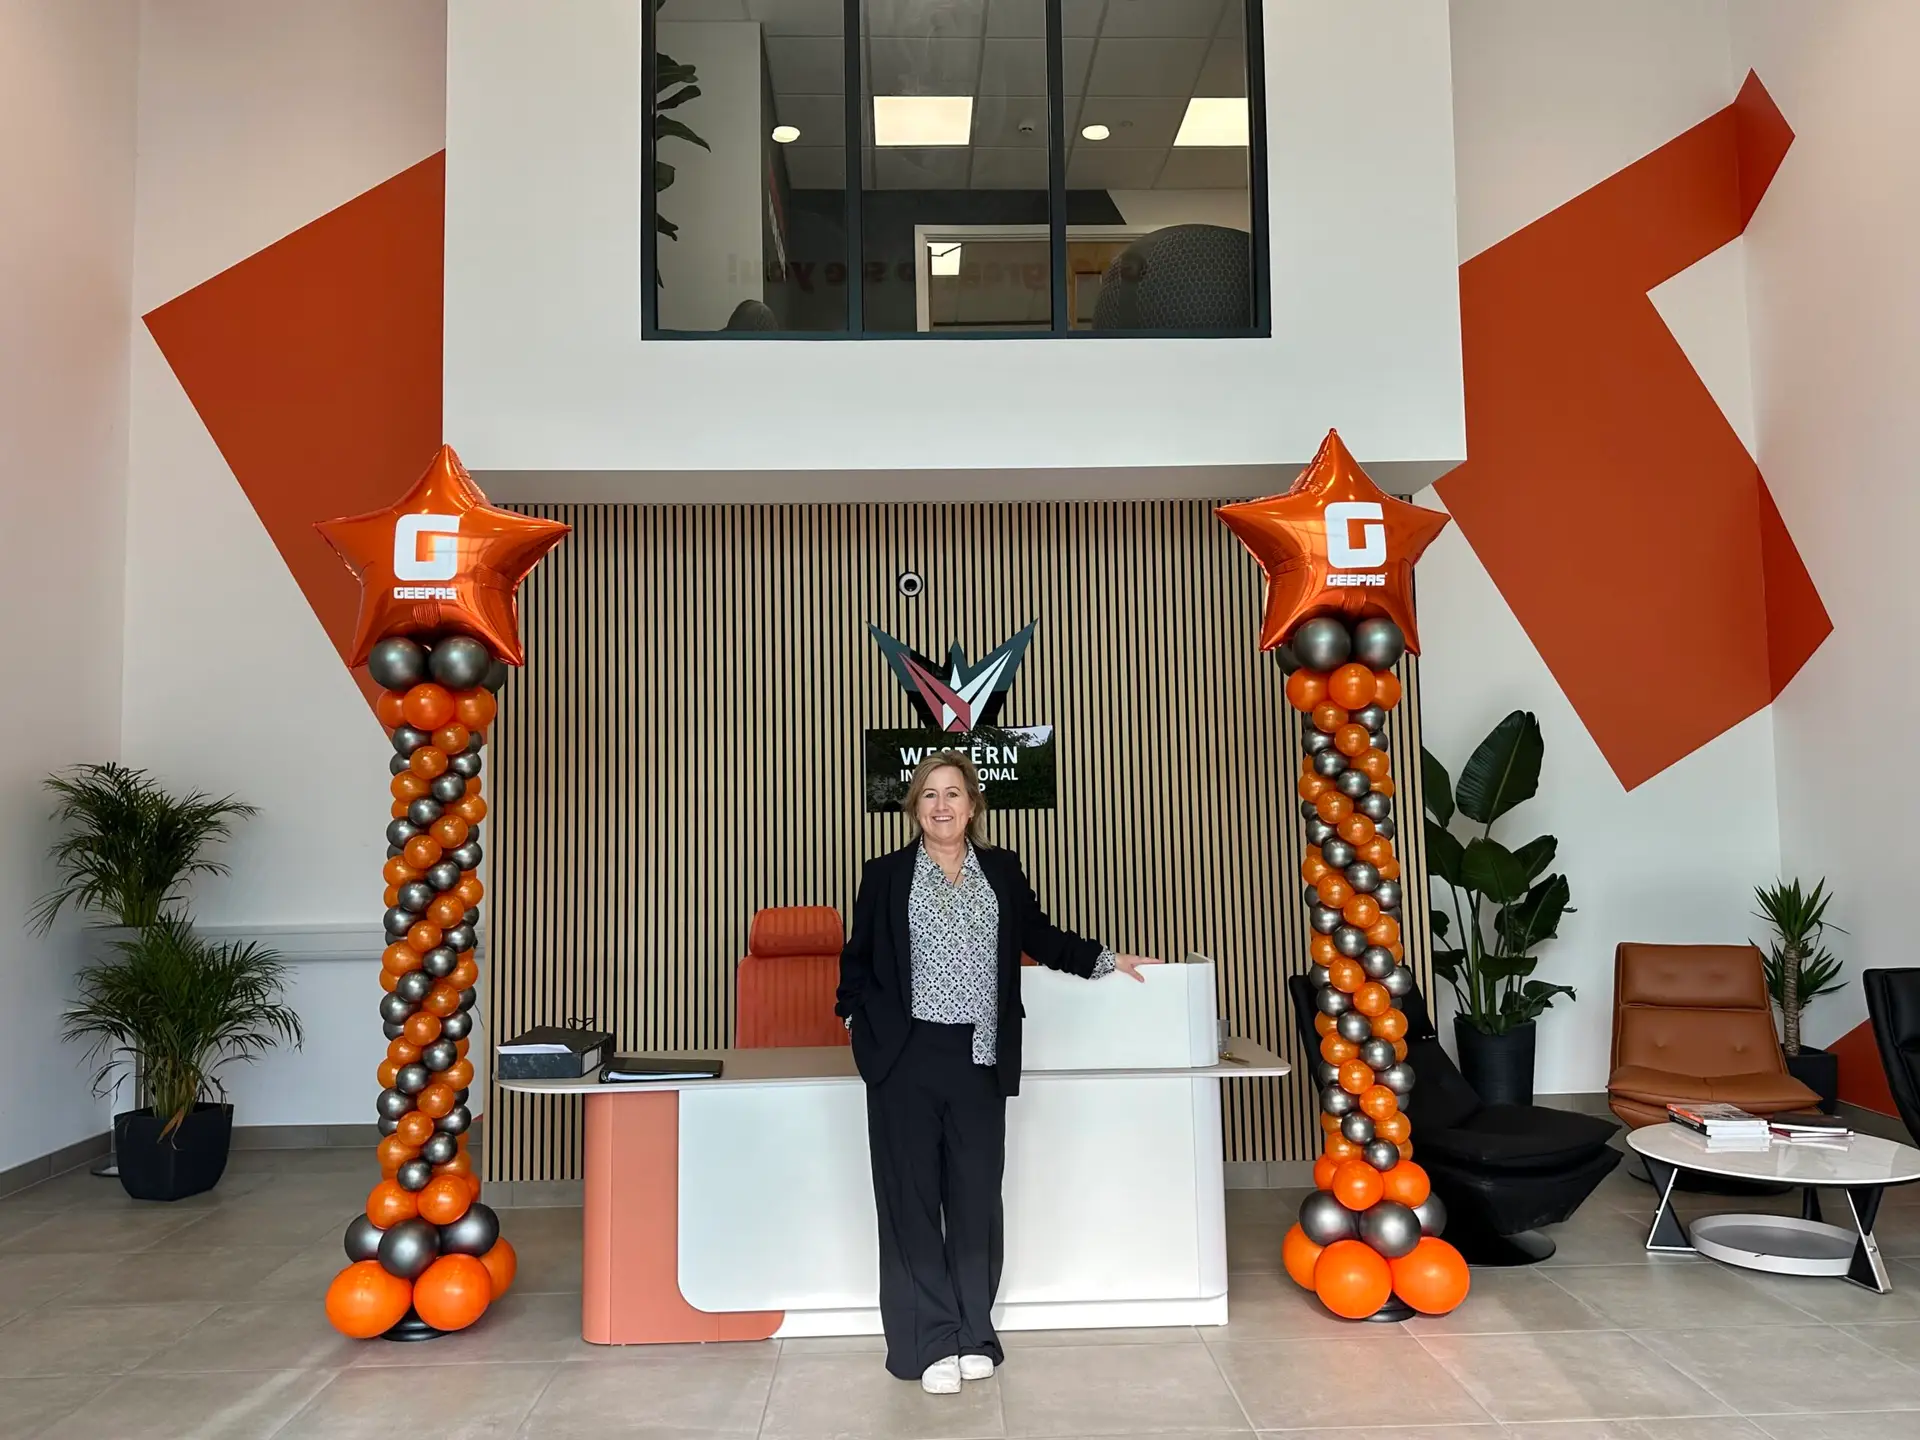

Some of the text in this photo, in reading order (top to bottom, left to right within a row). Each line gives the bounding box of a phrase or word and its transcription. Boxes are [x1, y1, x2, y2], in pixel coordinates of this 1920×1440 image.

[1324, 502, 1387, 569] G
[394, 513, 461, 581] G
[1326, 573, 1386, 587] GEEPAS
[393, 586, 458, 600] GEEPAS
[899, 746, 1018, 765] WERN
